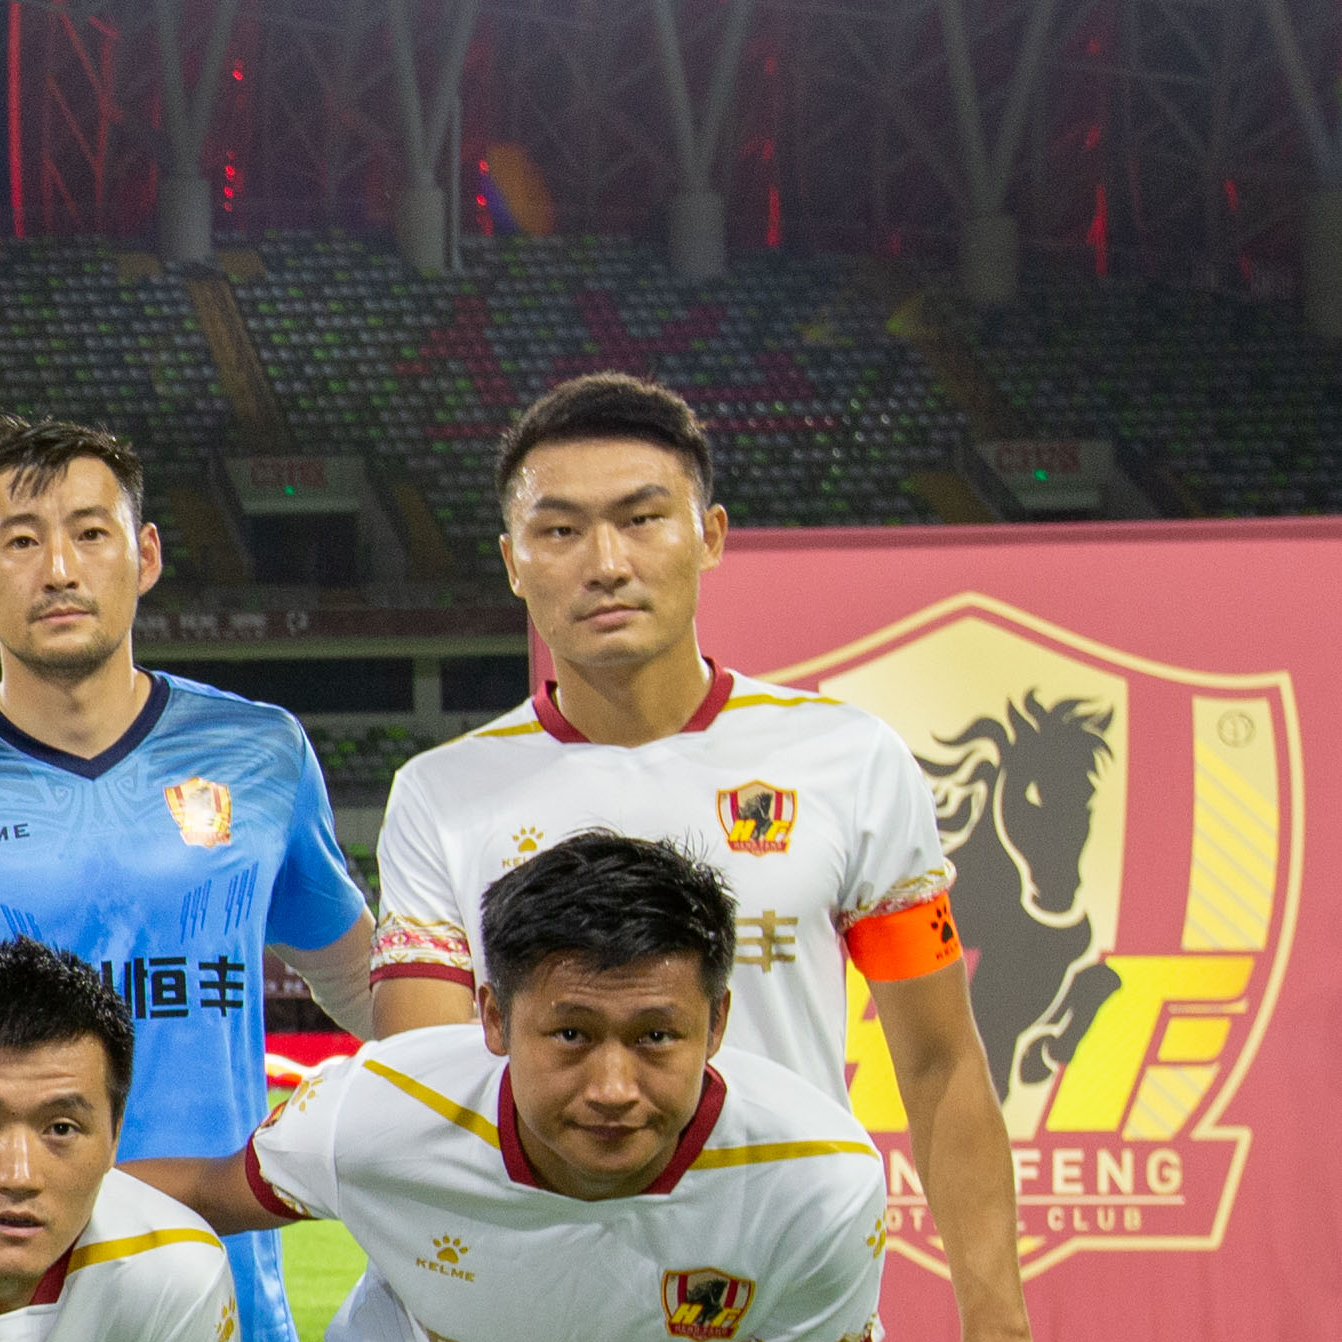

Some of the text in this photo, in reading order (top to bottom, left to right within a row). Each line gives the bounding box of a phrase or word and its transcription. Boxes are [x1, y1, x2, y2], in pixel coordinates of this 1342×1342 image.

[102, 955, 245, 1020] 恒丰
[1015, 1149, 1183, 1195] FENG
[1048, 1207, 1142, 1233] CLUB
[416, 1258, 476, 1282] KELME
